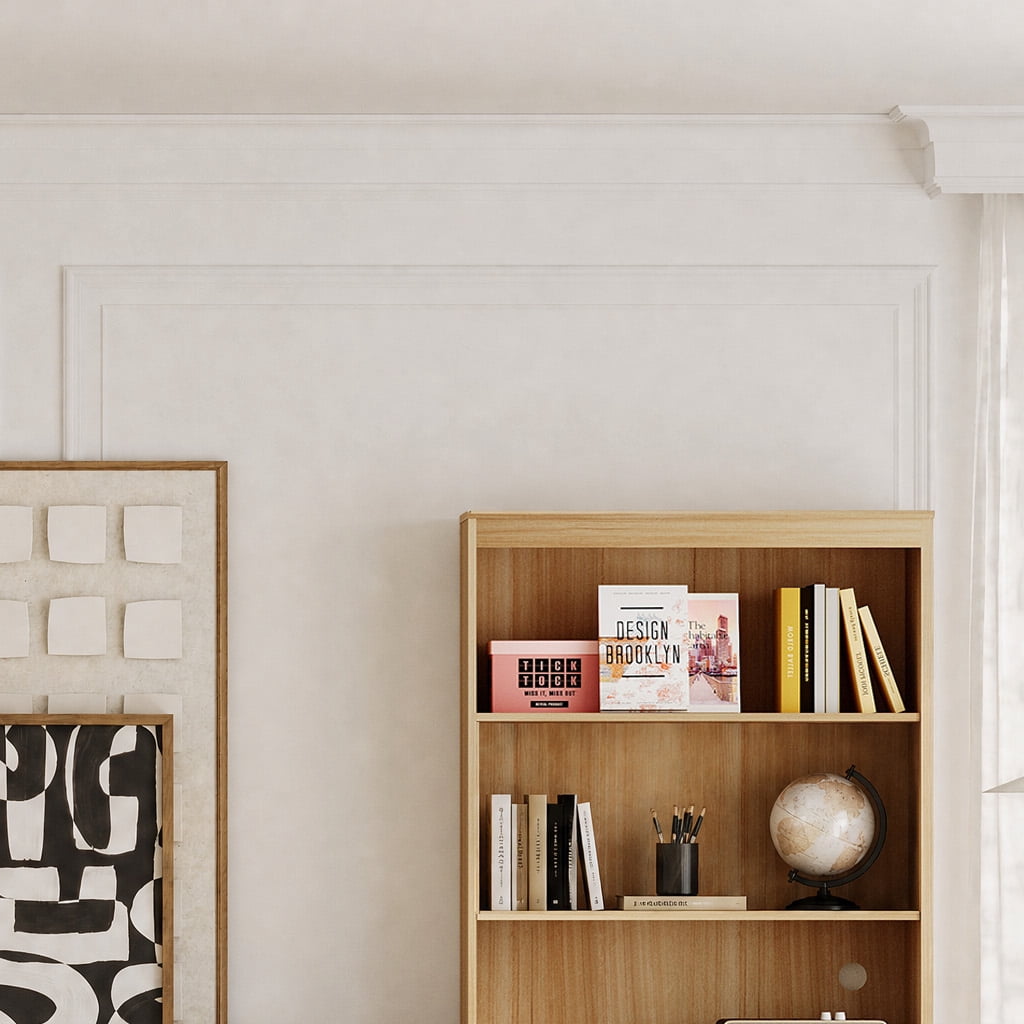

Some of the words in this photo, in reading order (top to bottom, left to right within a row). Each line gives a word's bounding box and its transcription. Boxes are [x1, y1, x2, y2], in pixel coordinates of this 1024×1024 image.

[688, 620, 706, 629] The
[616, 620, 669, 640] DESIGN
[606, 645, 680, 664] BROOKLYN
[523, 661, 577, 671] TICK
[523, 676, 577, 686] TOCK
